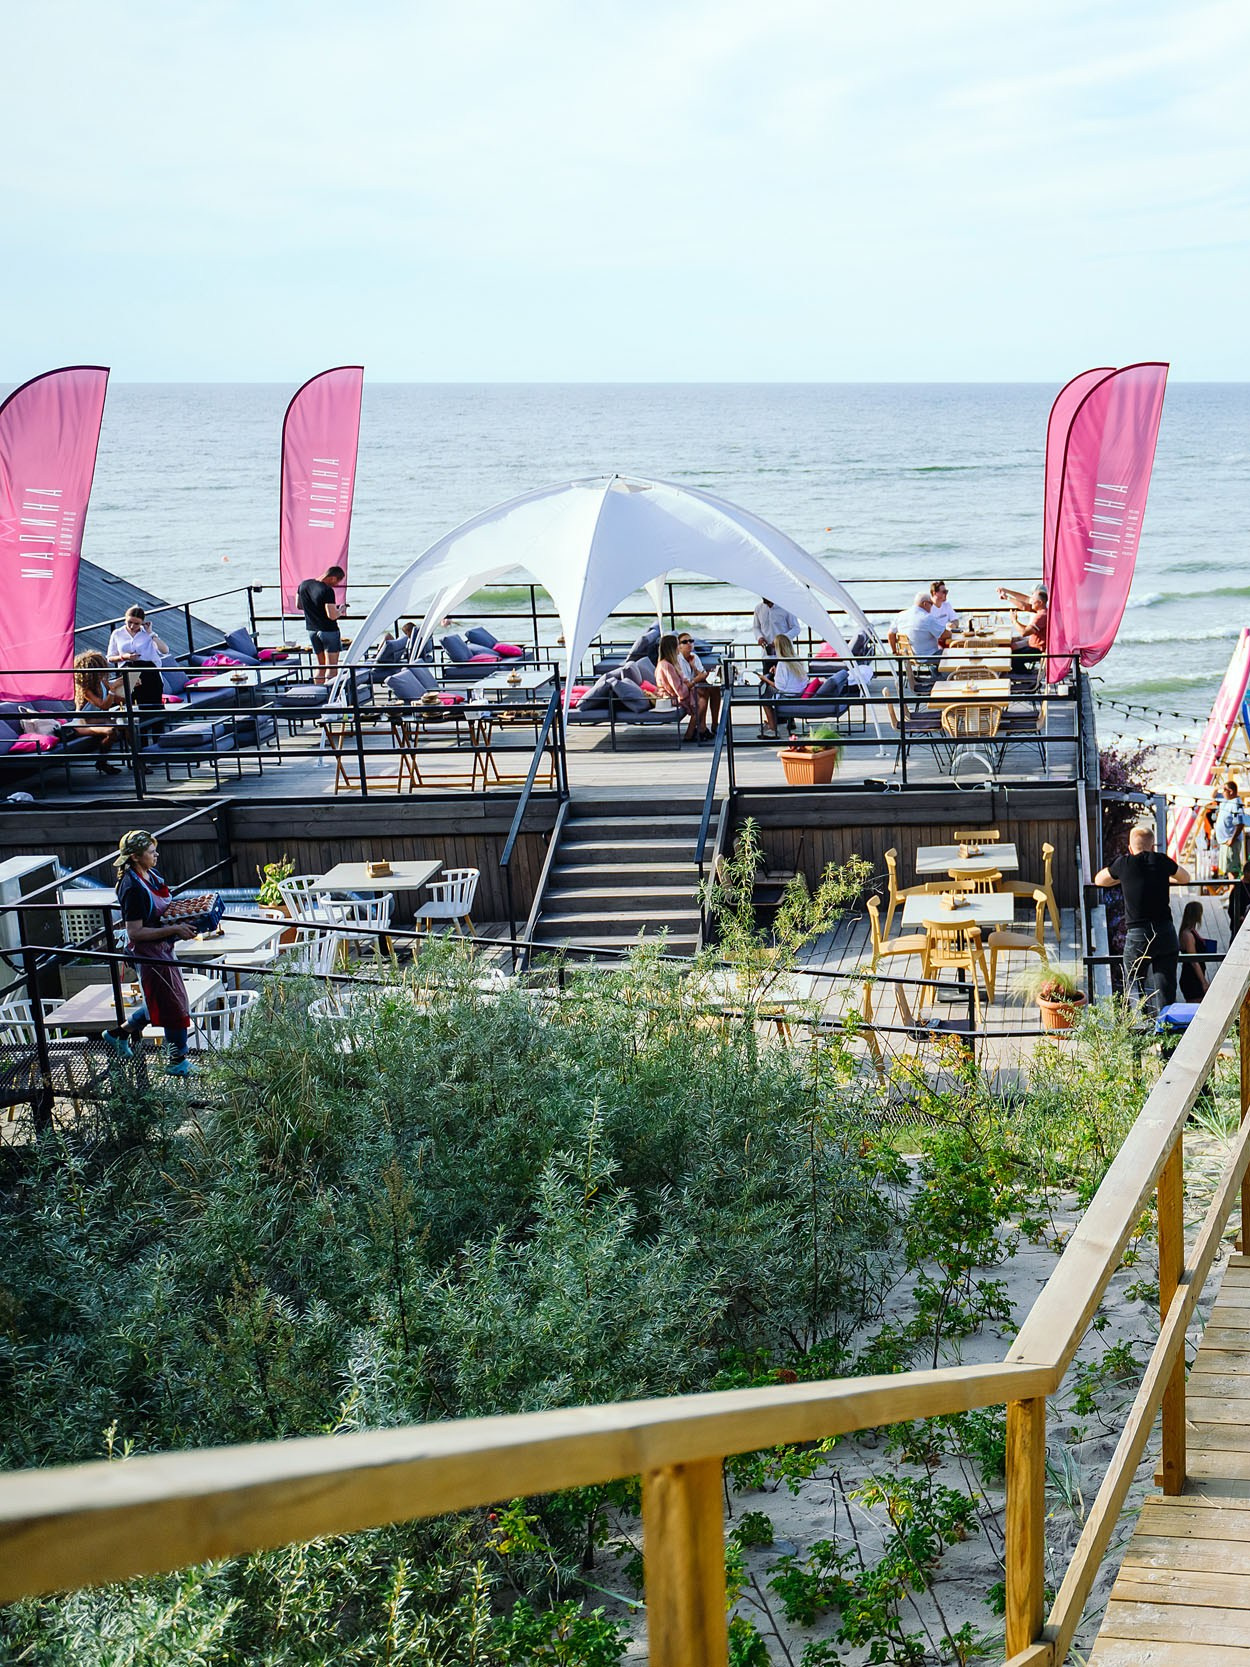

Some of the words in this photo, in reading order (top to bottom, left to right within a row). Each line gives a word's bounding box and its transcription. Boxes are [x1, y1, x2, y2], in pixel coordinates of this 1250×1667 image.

[19, 488, 63, 579] МАЛИНА
[308, 458, 340, 529] МАЛИНА
[1083, 483, 1129, 576] МАЛИНА
